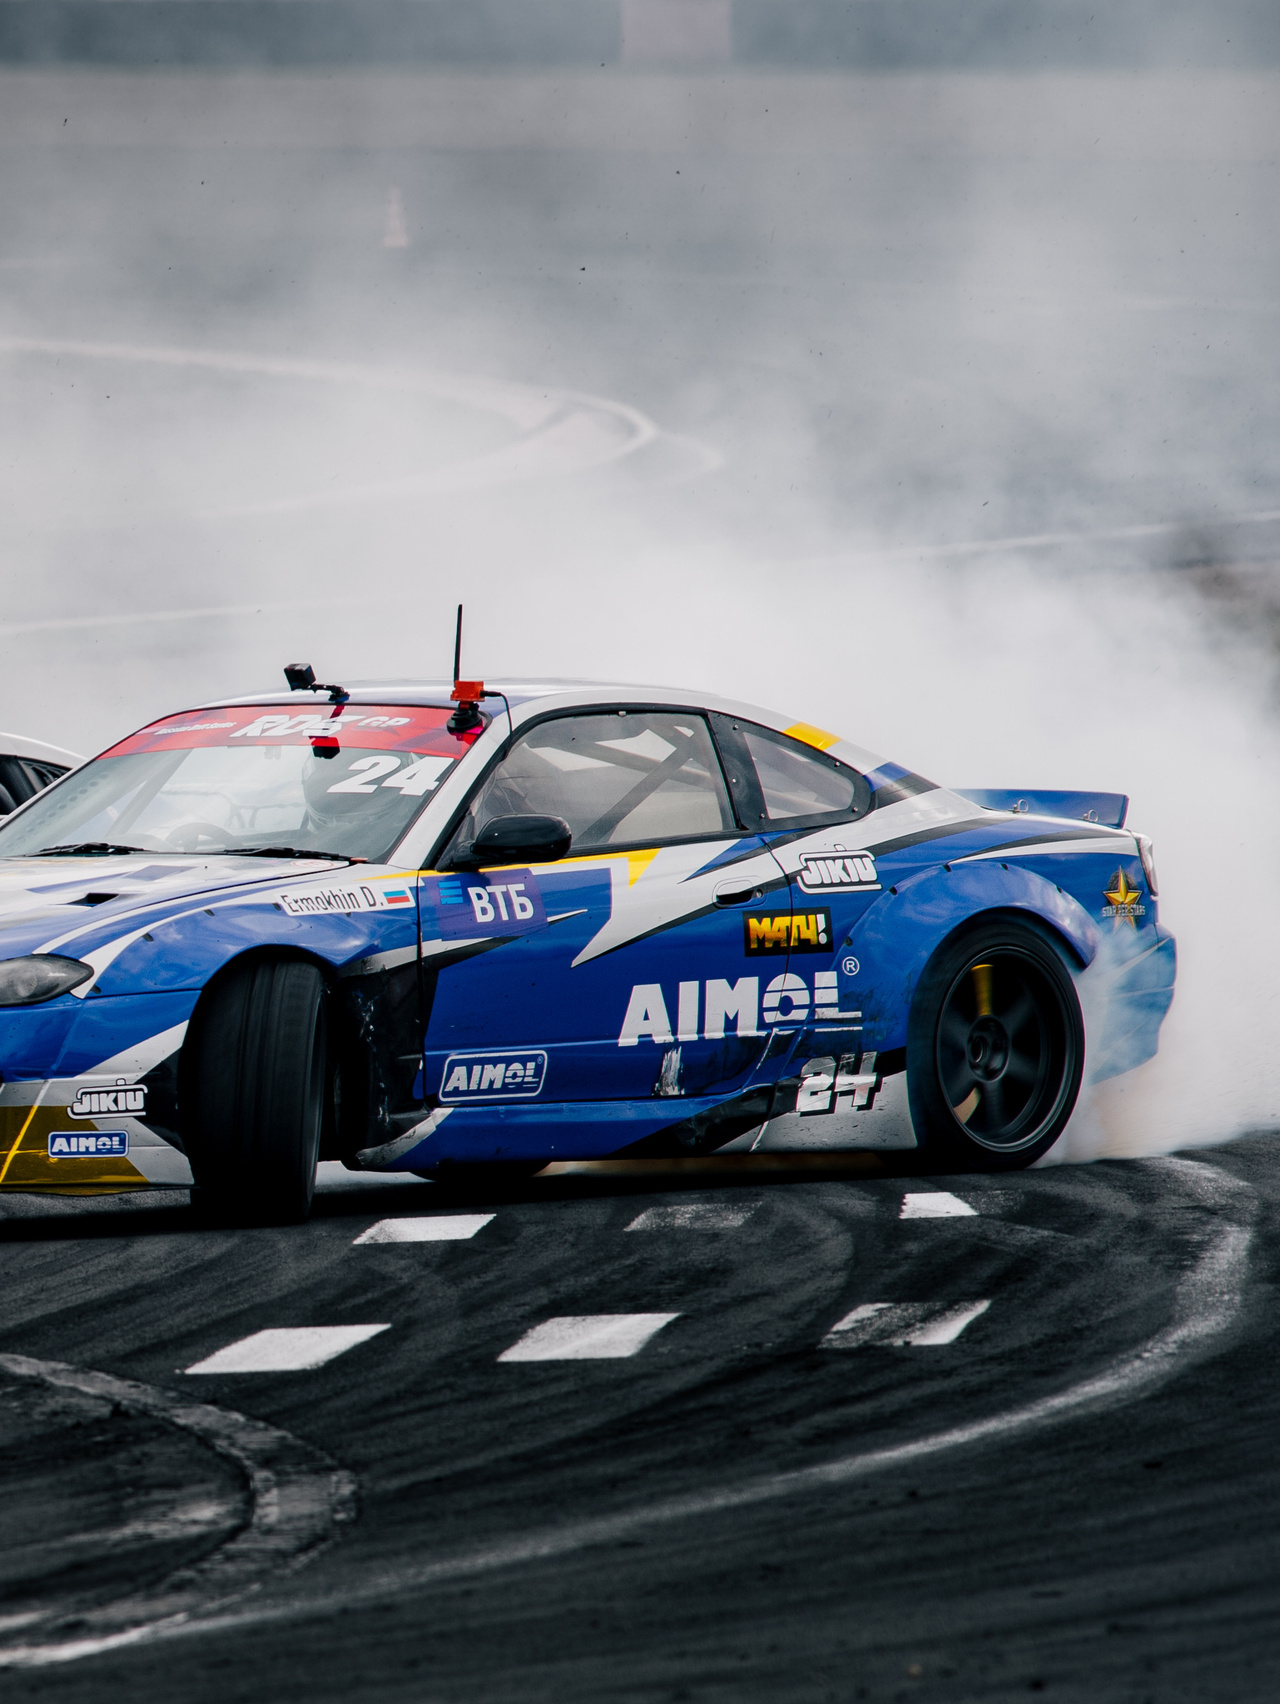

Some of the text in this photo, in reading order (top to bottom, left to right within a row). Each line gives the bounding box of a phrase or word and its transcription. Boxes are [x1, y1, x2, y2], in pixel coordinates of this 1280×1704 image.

[229, 714, 366, 738] RDS
[326, 755, 455, 797] 24
[800, 857, 878, 886] JIKIU
[281, 886, 384, 913] Ermokhin D.
[468, 883, 534, 923] ВТБ
[618, 971, 862, 1046] AIMOL
[444, 1061, 539, 1092] AIMOL
[796, 1051, 880, 1115] 24
[72, 1090, 145, 1114] JIKIU
[51, 1136, 125, 1152] AIMOL
